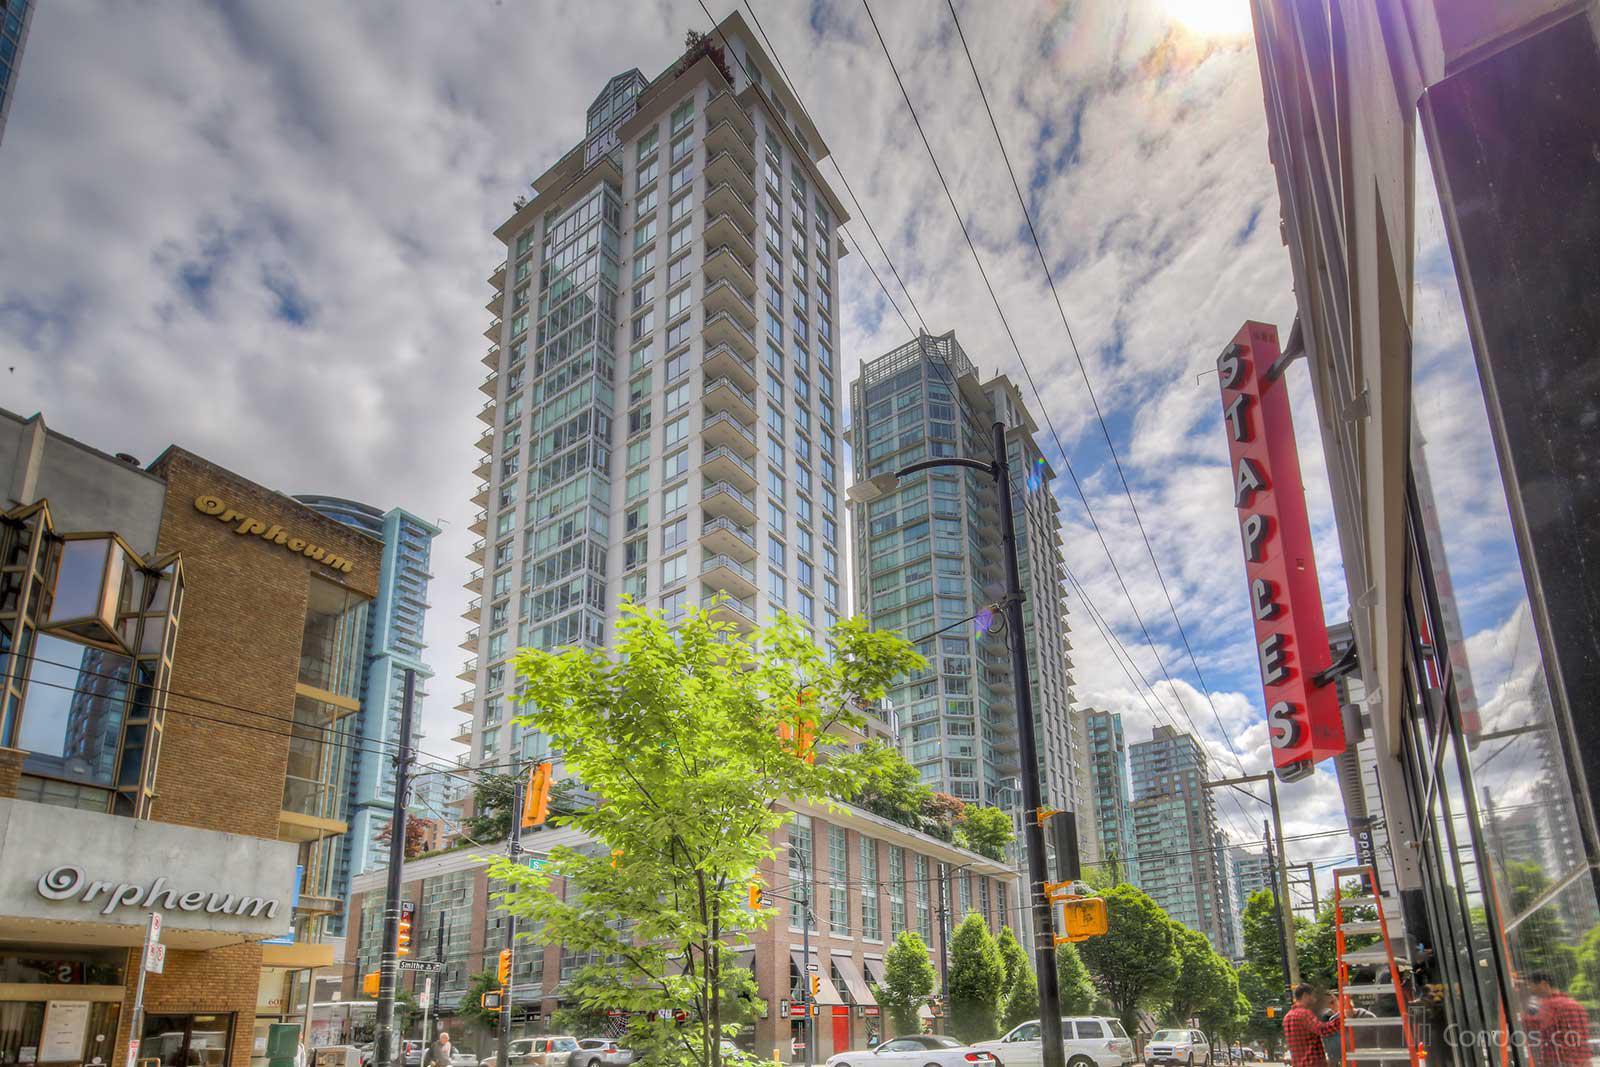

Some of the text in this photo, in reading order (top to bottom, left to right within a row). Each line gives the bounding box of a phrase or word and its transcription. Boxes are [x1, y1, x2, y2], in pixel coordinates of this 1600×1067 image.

[194, 495, 354, 573] Orpheum
[1218, 343, 1297, 749] STAPLES
[37, 864, 281, 919] Orpheum
[401, 961, 425, 970] Smithe
